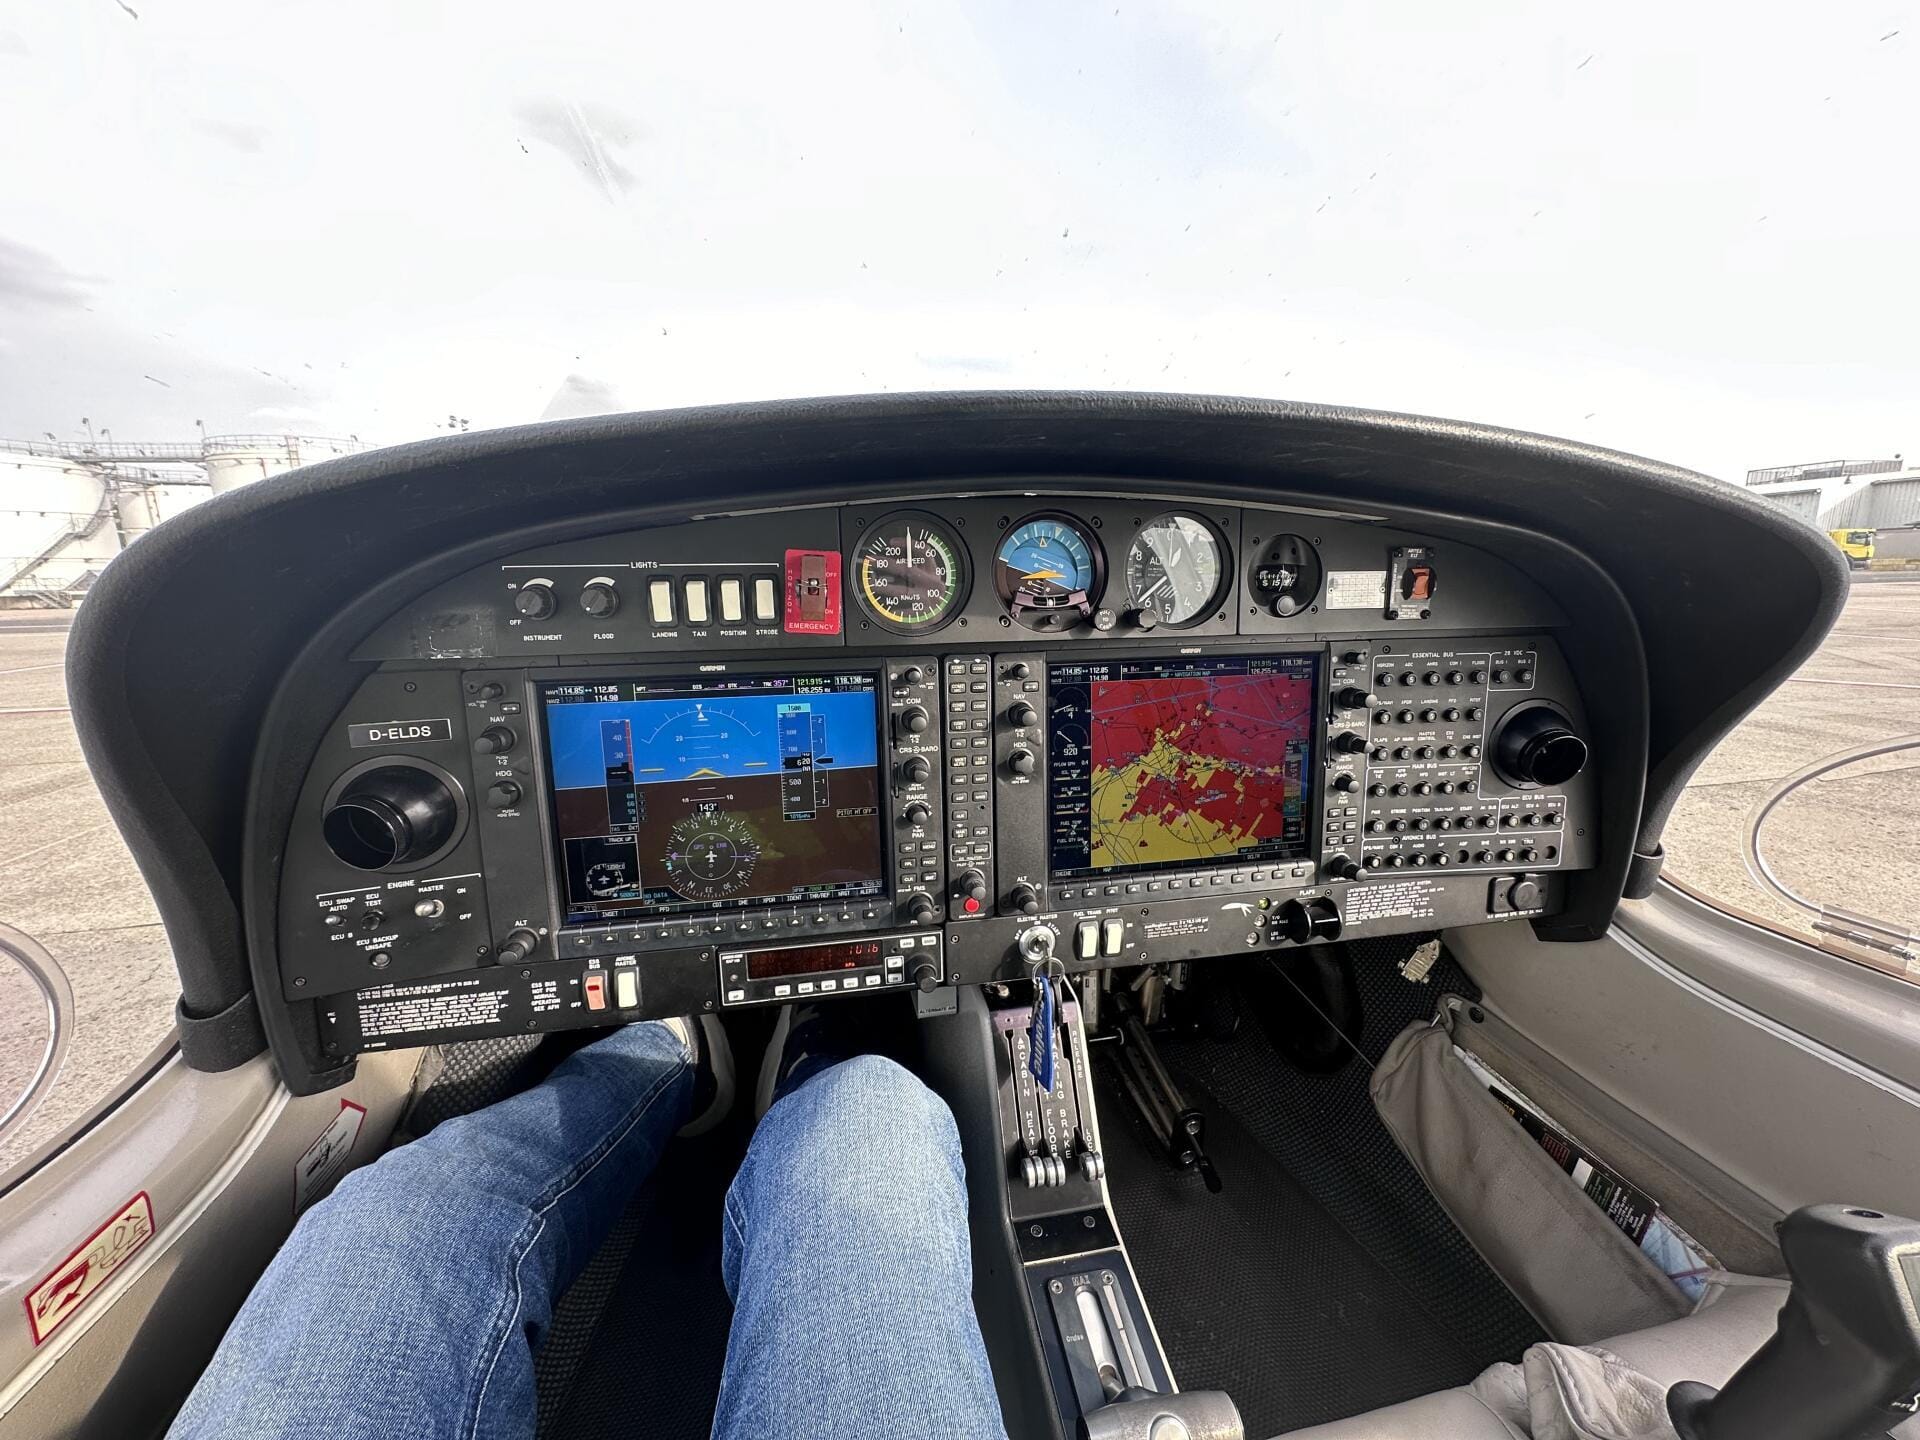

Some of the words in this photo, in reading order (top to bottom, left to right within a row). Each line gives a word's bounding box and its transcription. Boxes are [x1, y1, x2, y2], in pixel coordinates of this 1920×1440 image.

[914, 541, 925, 549] 40
[1147, 537, 1153, 548] 9
[885, 547, 901, 556] 200
[925, 550, 936, 558] 60
[1136, 551, 1142, 560] 8
[1197, 552, 1202, 563] 2
[630, 561, 658, 569] LIGHTS
[876, 560, 888, 568] 180
[935, 567, 945, 576] 80
[874, 578, 888, 587] 160
[1195, 581, 1202, 591] 3
[927, 589, 940, 598] 100
[1136, 585, 1141, 595] 7
[886, 597, 899, 605] 140
[1145, 597, 1151, 607] 6
[1184, 597, 1190, 607] 4
[912, 602, 923, 611] 120
[1165, 604, 1171, 614] 5
[789, 622, 834, 631] EMERGENCY
[523, 634, 562, 642] INSTRUMENT
[559, 686, 584, 694] 114.85
[369, 726, 431, 741] D-ELDS
[699, 803, 717, 811] 143°
[387, 880, 415, 889] ENGINE
[418, 885, 444, 893] MASTER
[336, 897, 355, 905] SWAP
[365, 899, 382, 907] TEST
[372, 934, 399, 944] BACKUP
[365, 942, 392, 951] UNSAFE
[531, 998, 560, 1006] OPERATION
[1072, 1031, 1084, 1078] RELEASE
[1019, 1052, 1030, 1096] CABIN
[1026, 1111, 1035, 1145] HEAT
[1059, 1109, 1072, 1159] BRAKE
[1072, 1275, 1091, 1285] MAX
[1065, 1334, 1084, 1342] Cruise
